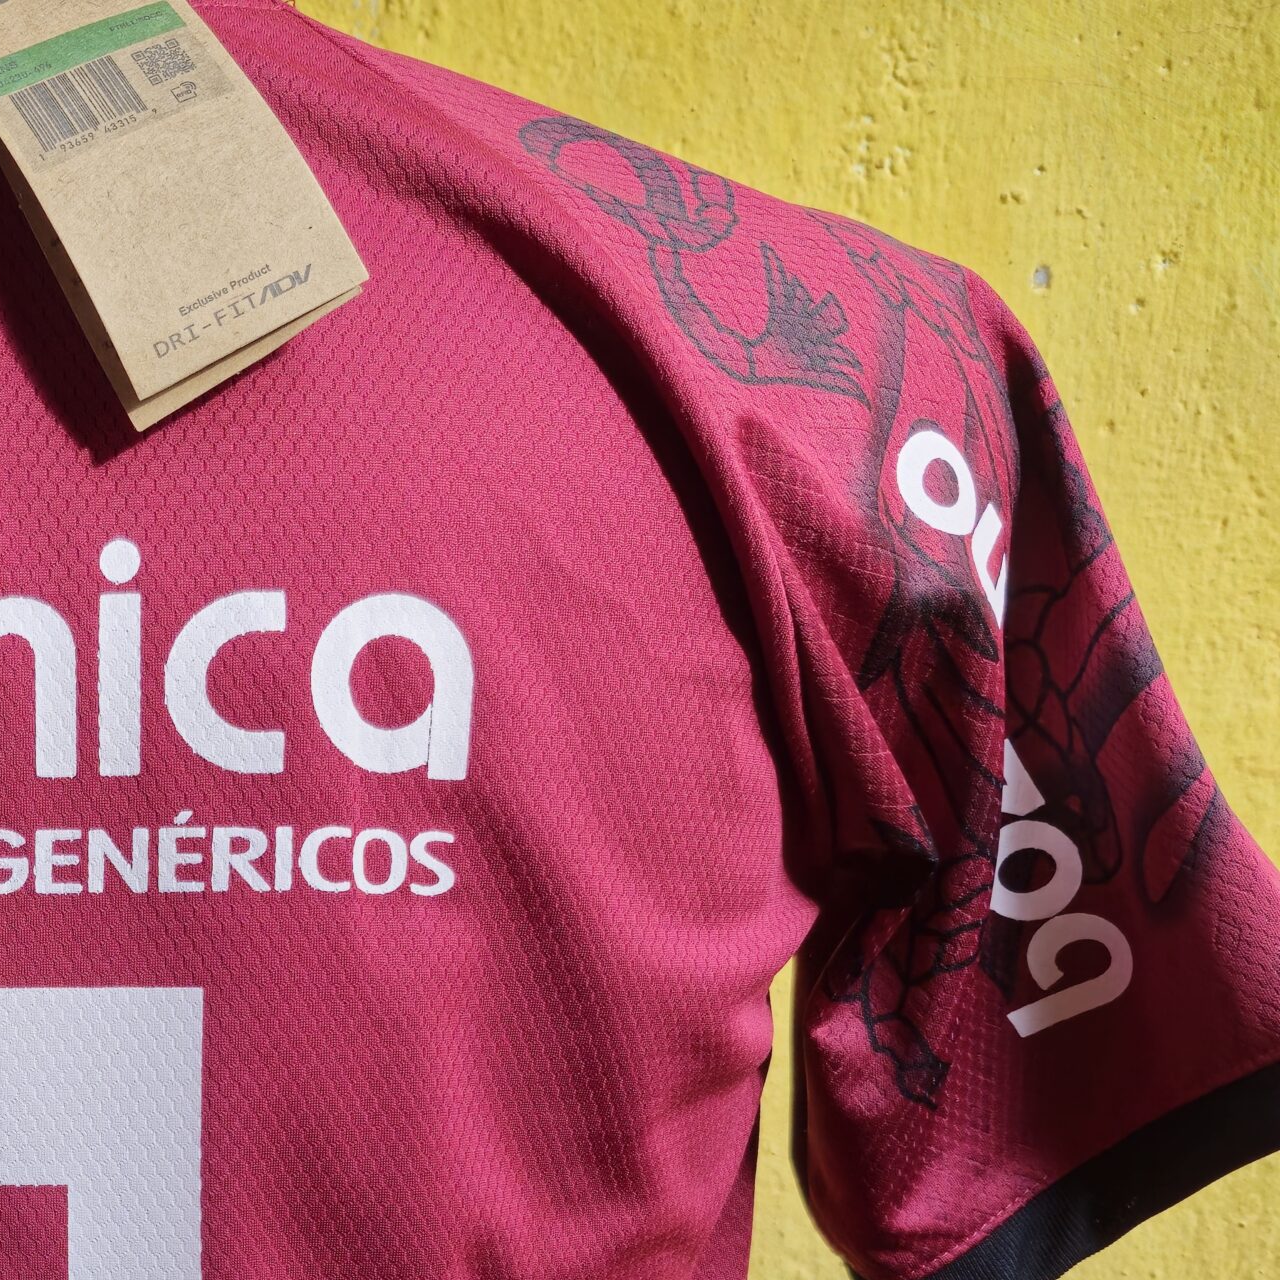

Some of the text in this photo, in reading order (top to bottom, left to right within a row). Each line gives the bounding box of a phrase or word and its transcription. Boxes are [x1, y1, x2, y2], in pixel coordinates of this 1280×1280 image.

[59, 131, 96, 153] 93659
[103, 114, 138, 134] 43315
[178, 263, 272, 317] Exclusive Product
